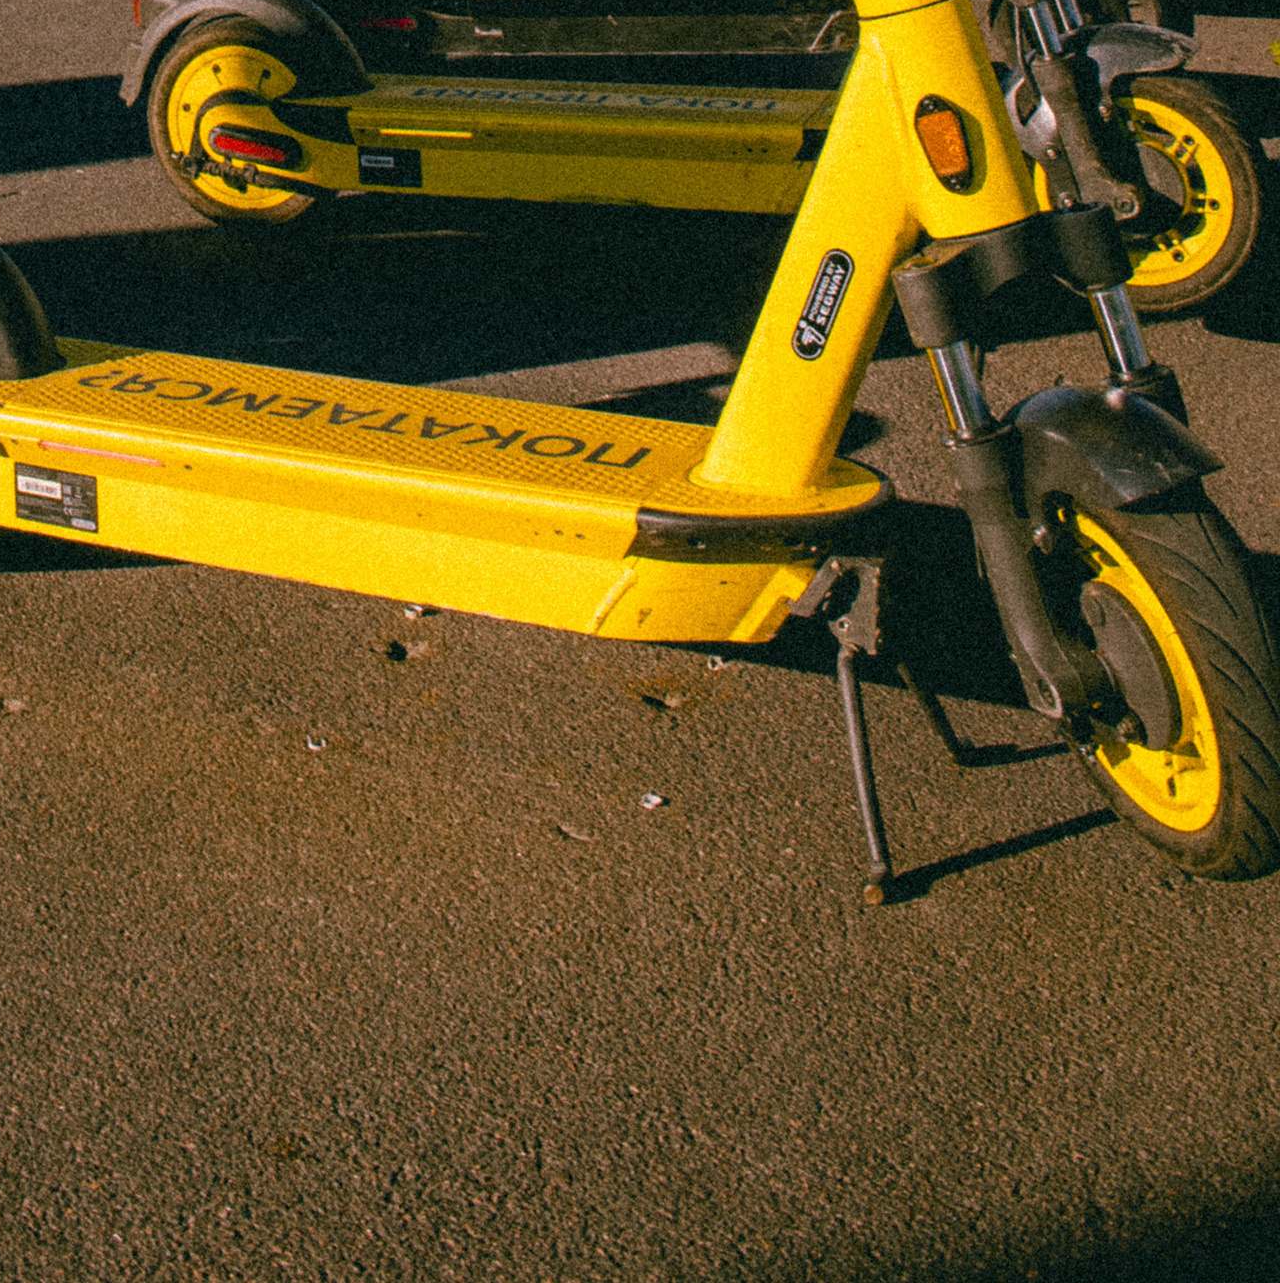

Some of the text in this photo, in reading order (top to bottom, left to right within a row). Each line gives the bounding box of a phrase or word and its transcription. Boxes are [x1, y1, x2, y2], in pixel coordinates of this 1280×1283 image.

[412, 87, 609, 105] ПРОБКИ
[808, 262, 836, 322] POWERED BY
[816, 265, 846, 326] SEGWAY
[77, 371, 652, 470] ПОКАТАЕМСЯ?
